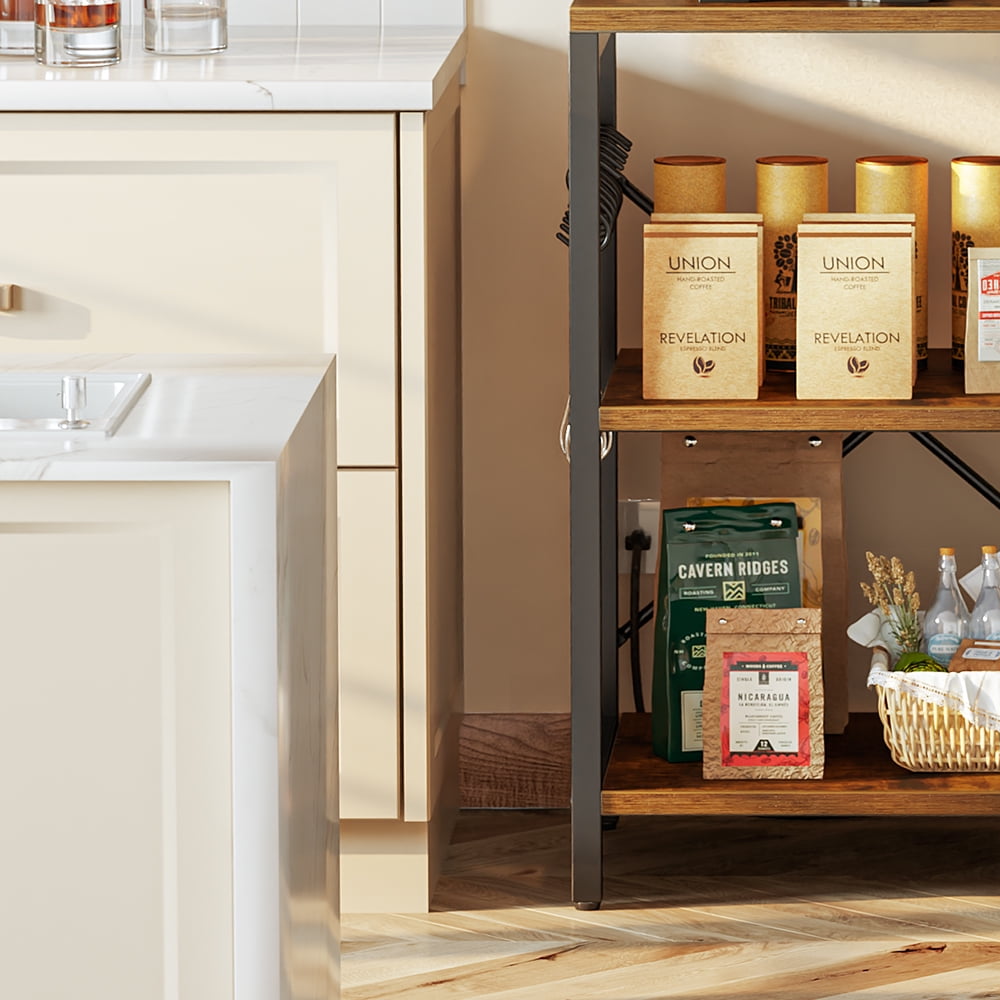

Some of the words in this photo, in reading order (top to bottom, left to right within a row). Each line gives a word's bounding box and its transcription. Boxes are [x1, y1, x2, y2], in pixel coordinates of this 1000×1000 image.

[668, 256, 731, 270] UNION
[823, 256, 885, 270] UNION
[660, 332, 746, 344] REVELATION
[814, 332, 900, 344] REVELATION
[678, 561, 734, 580] CAVERN
[738, 559, 789, 577] RIDGES
[683, 589, 715, 597] ROASTING
[737, 693, 790, 701] NICARAGUA
